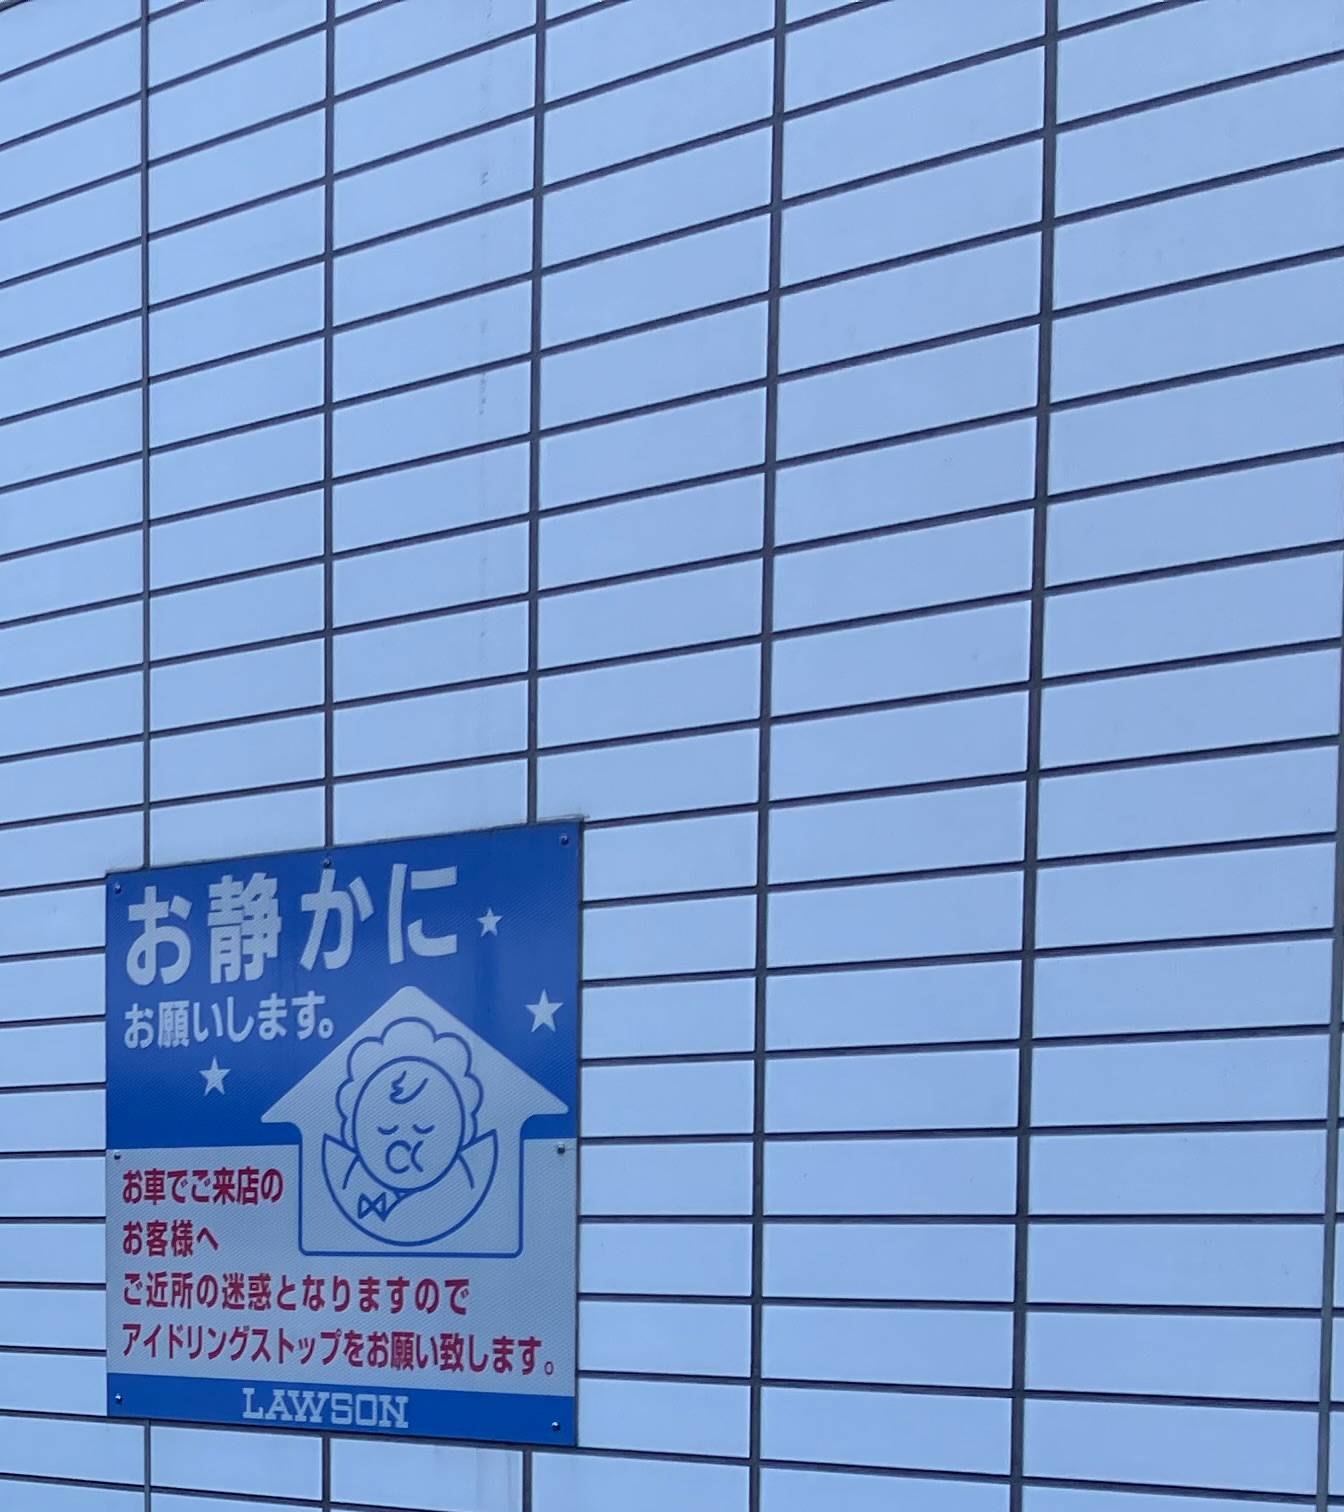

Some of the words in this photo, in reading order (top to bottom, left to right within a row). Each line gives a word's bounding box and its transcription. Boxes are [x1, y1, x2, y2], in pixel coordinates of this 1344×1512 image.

[125, 862, 459, 986] お静かに
[124, 990, 336, 1050] お願いします。
[122, 1167, 285, 1206] お車でご来店の
[122, 1219, 220, 1259] お客様へ
[122, 1272, 472, 1317] ご近所の迷惑となりますので
[122, 1322, 555, 1377] アイドリングストップをお願い致します。
[242, 1387, 410, 1429] LAWSON
